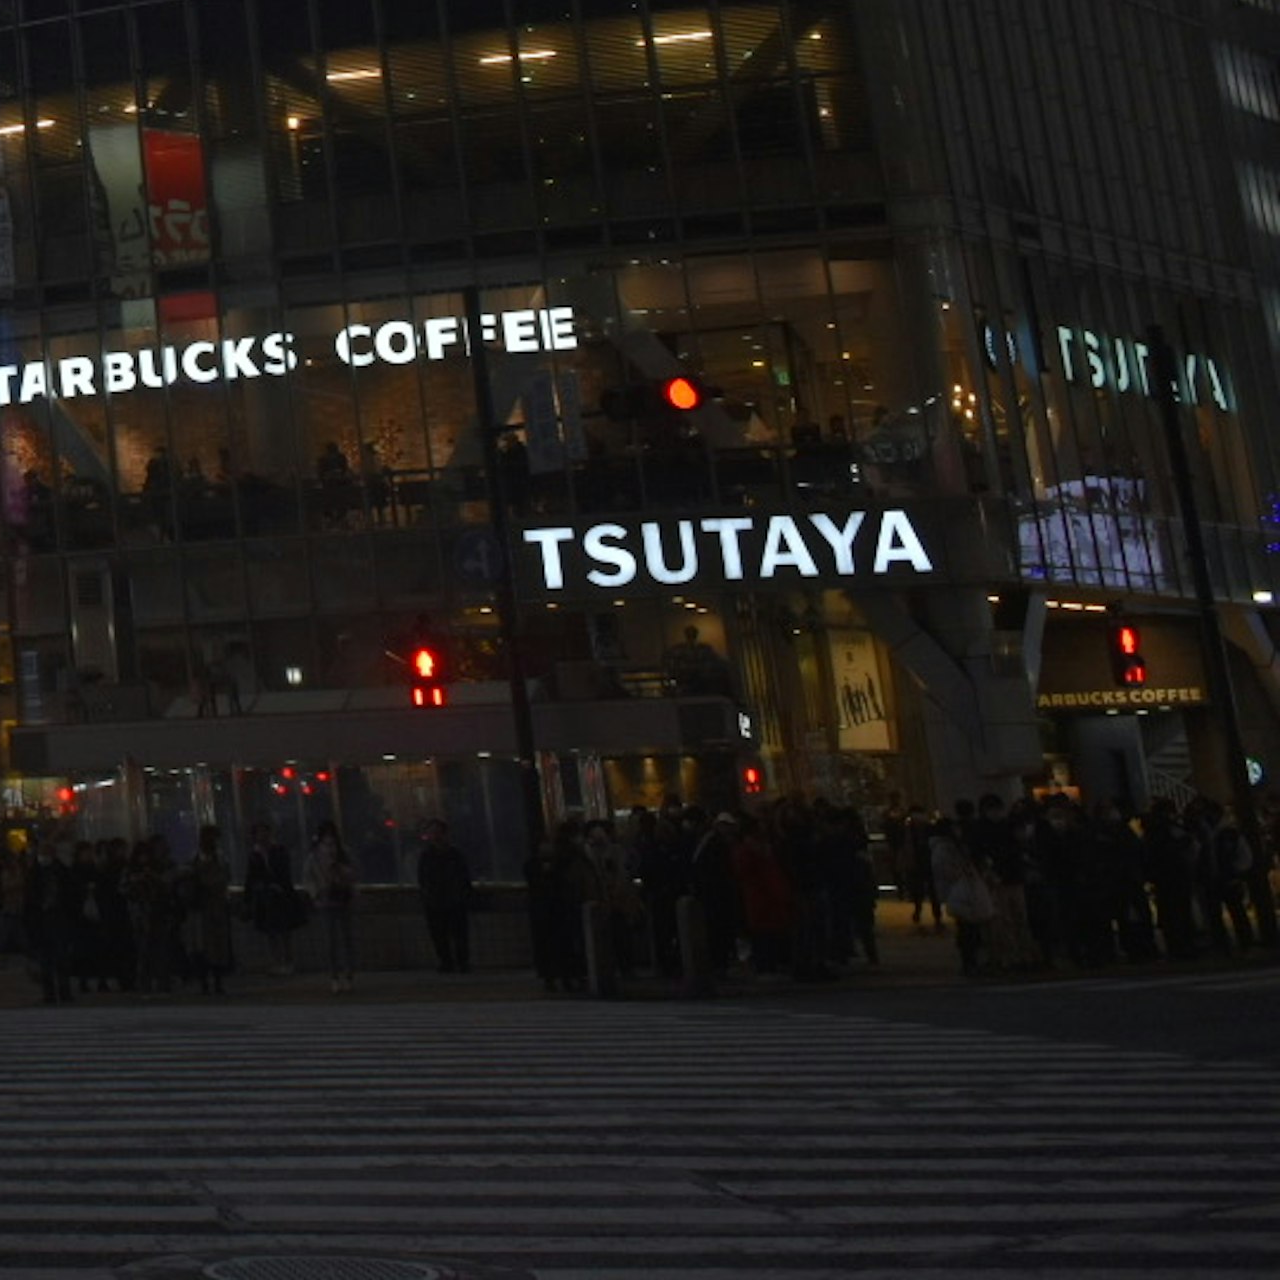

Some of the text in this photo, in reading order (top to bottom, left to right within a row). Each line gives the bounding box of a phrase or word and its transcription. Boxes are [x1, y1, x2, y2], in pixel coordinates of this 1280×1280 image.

[1056, 325, 1237, 413] TSUTYA
[522, 509, 933, 590] TSUTAYA
[1130, 688, 1201, 703] COFFEE
